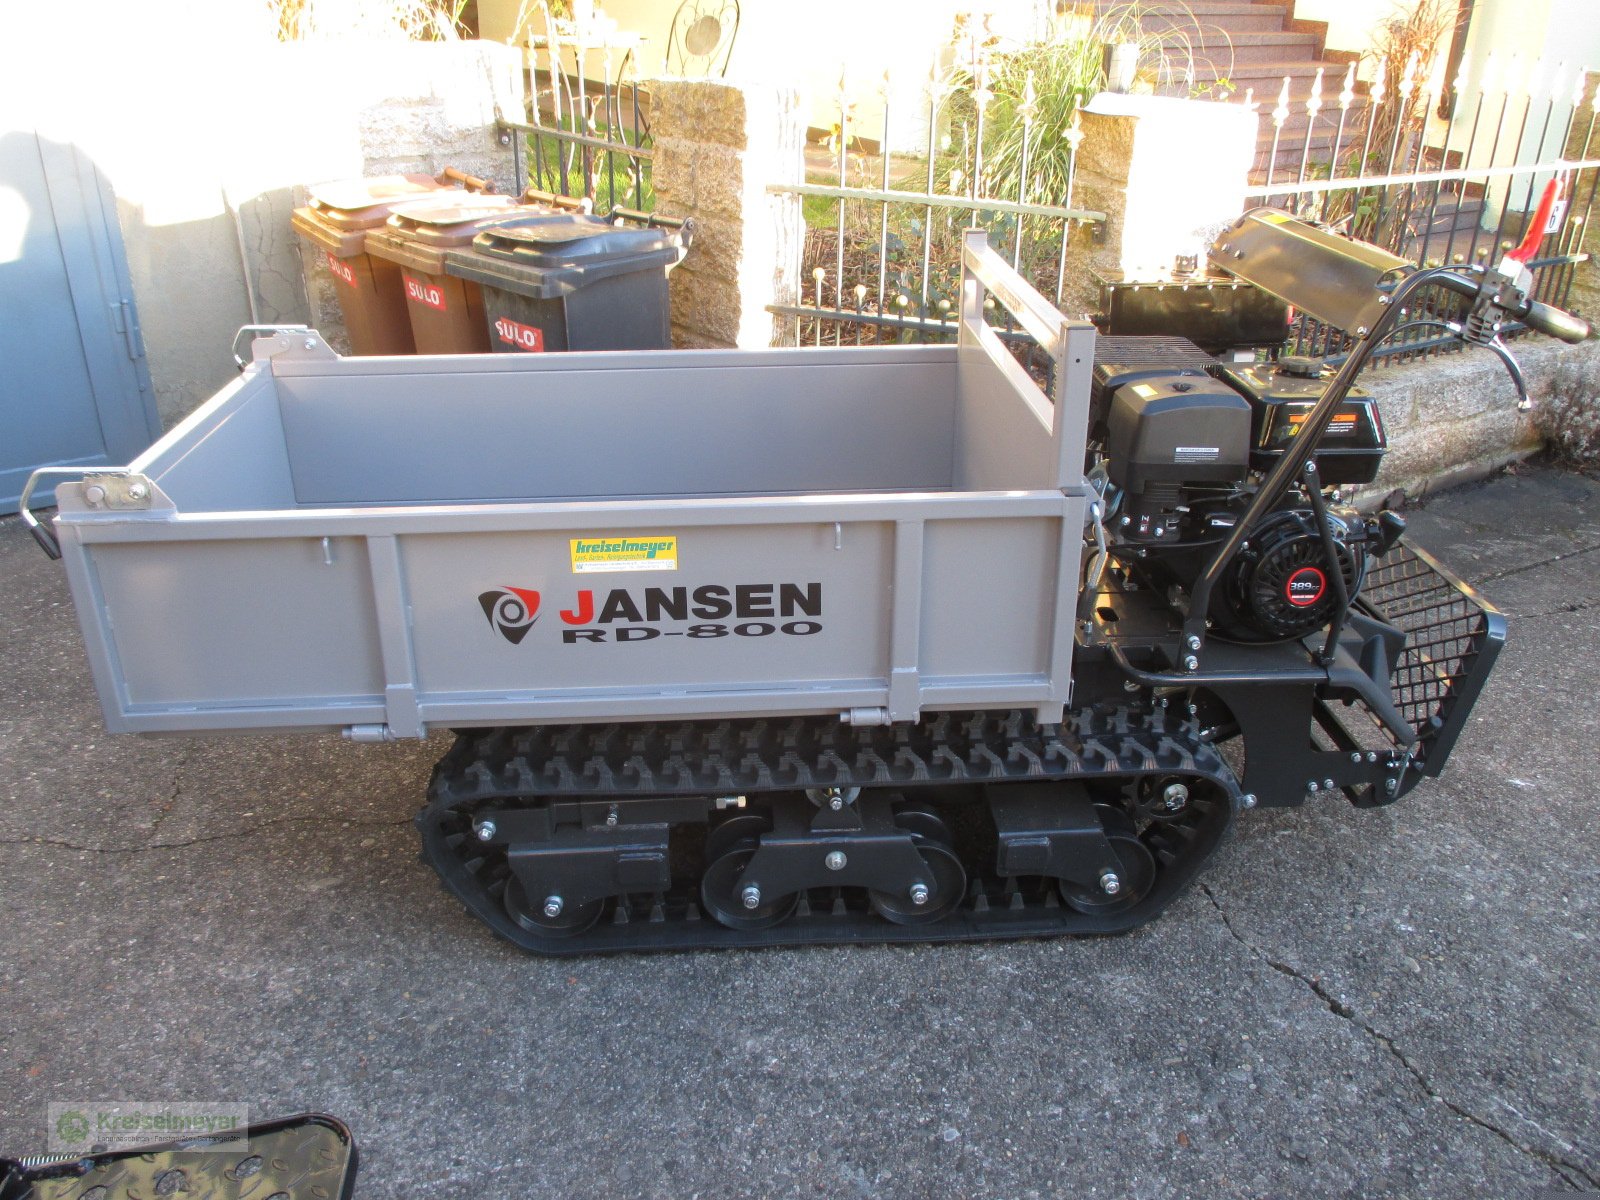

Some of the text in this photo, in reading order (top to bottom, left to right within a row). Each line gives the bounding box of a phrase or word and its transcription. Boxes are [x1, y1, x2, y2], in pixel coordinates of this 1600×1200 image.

[329, 255, 352, 282] SULO
[408, 281, 441, 306] SULO
[495, 320, 537, 347] SULO
[575, 539, 674, 559] kreiselmeyer
[559, 582, 823, 626] JANSEN
[562, 621, 824, 644] RD-800
